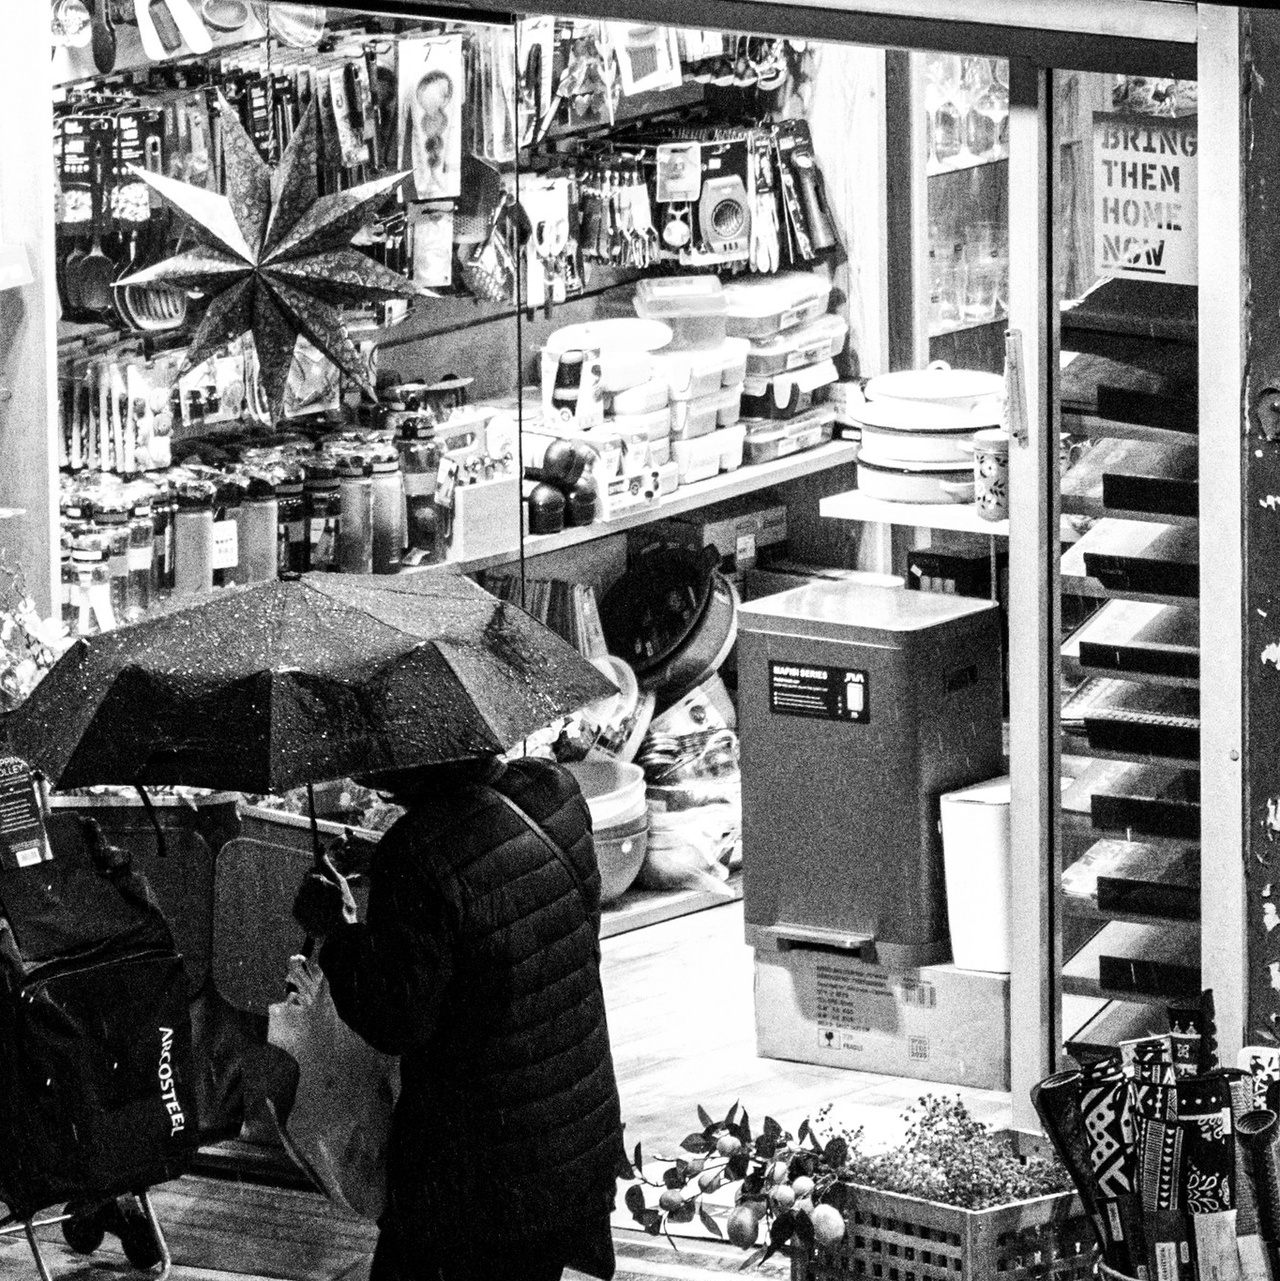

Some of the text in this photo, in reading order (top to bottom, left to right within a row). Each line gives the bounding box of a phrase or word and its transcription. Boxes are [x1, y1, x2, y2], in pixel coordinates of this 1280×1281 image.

[1102, 125, 1198, 157] BRING
[1102, 159, 1180, 193] THEM
[1102, 197, 1182, 231] HOME
[1103, 234, 1166, 267] NOW
[158, 1026, 185, 1137] ARCOSTEEL
